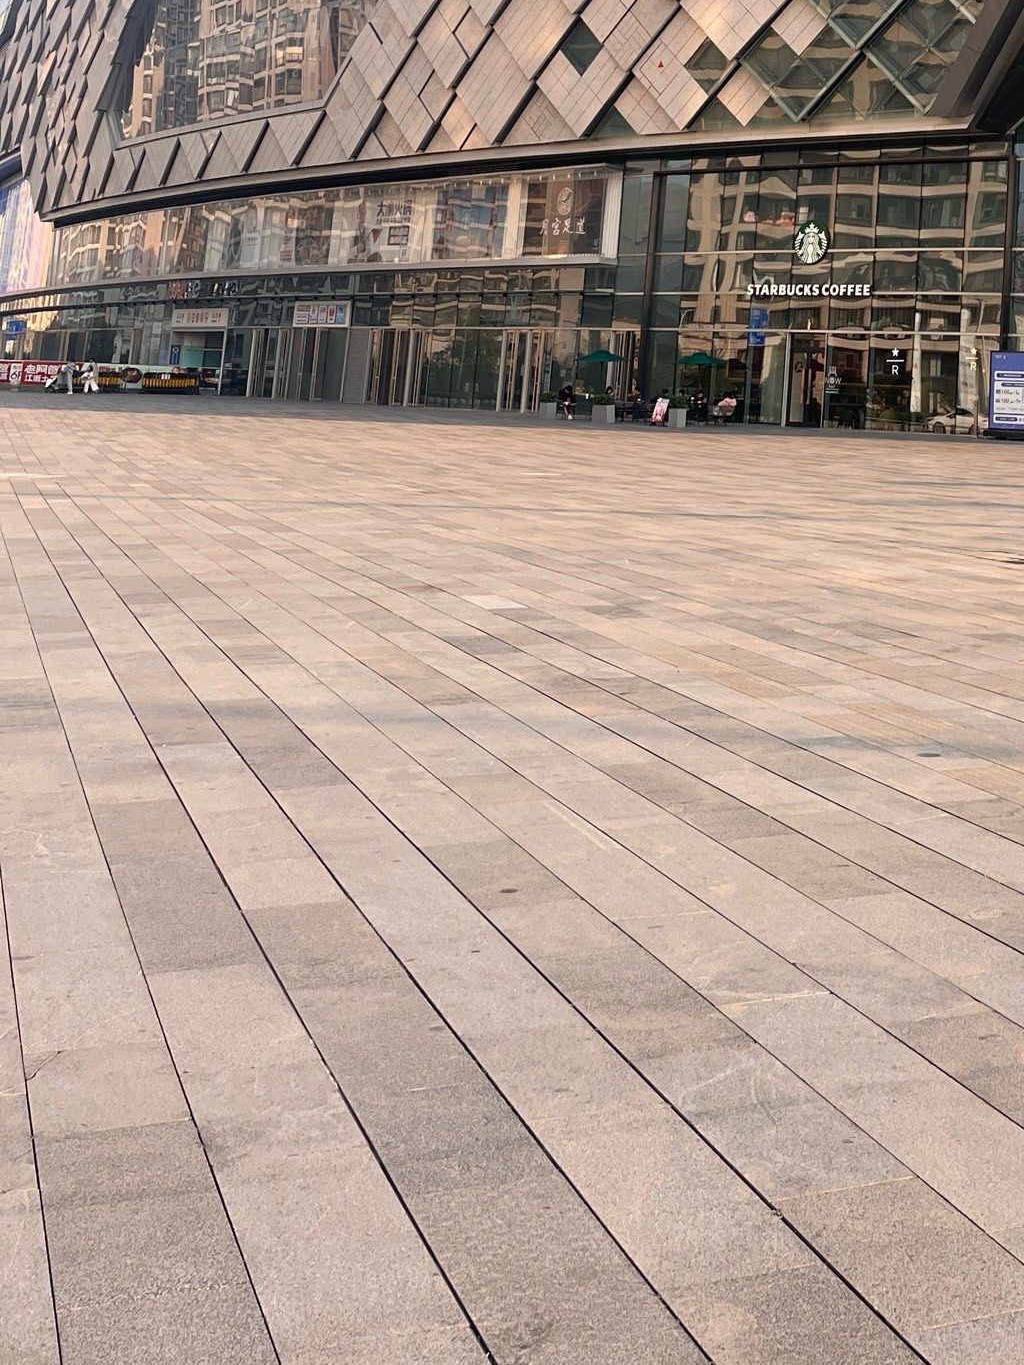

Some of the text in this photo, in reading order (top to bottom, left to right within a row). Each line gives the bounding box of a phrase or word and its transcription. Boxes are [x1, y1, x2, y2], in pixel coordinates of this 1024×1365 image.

[746, 283, 871, 296] STARBUCKS COFFEE
[891, 365, 899, 376] R
